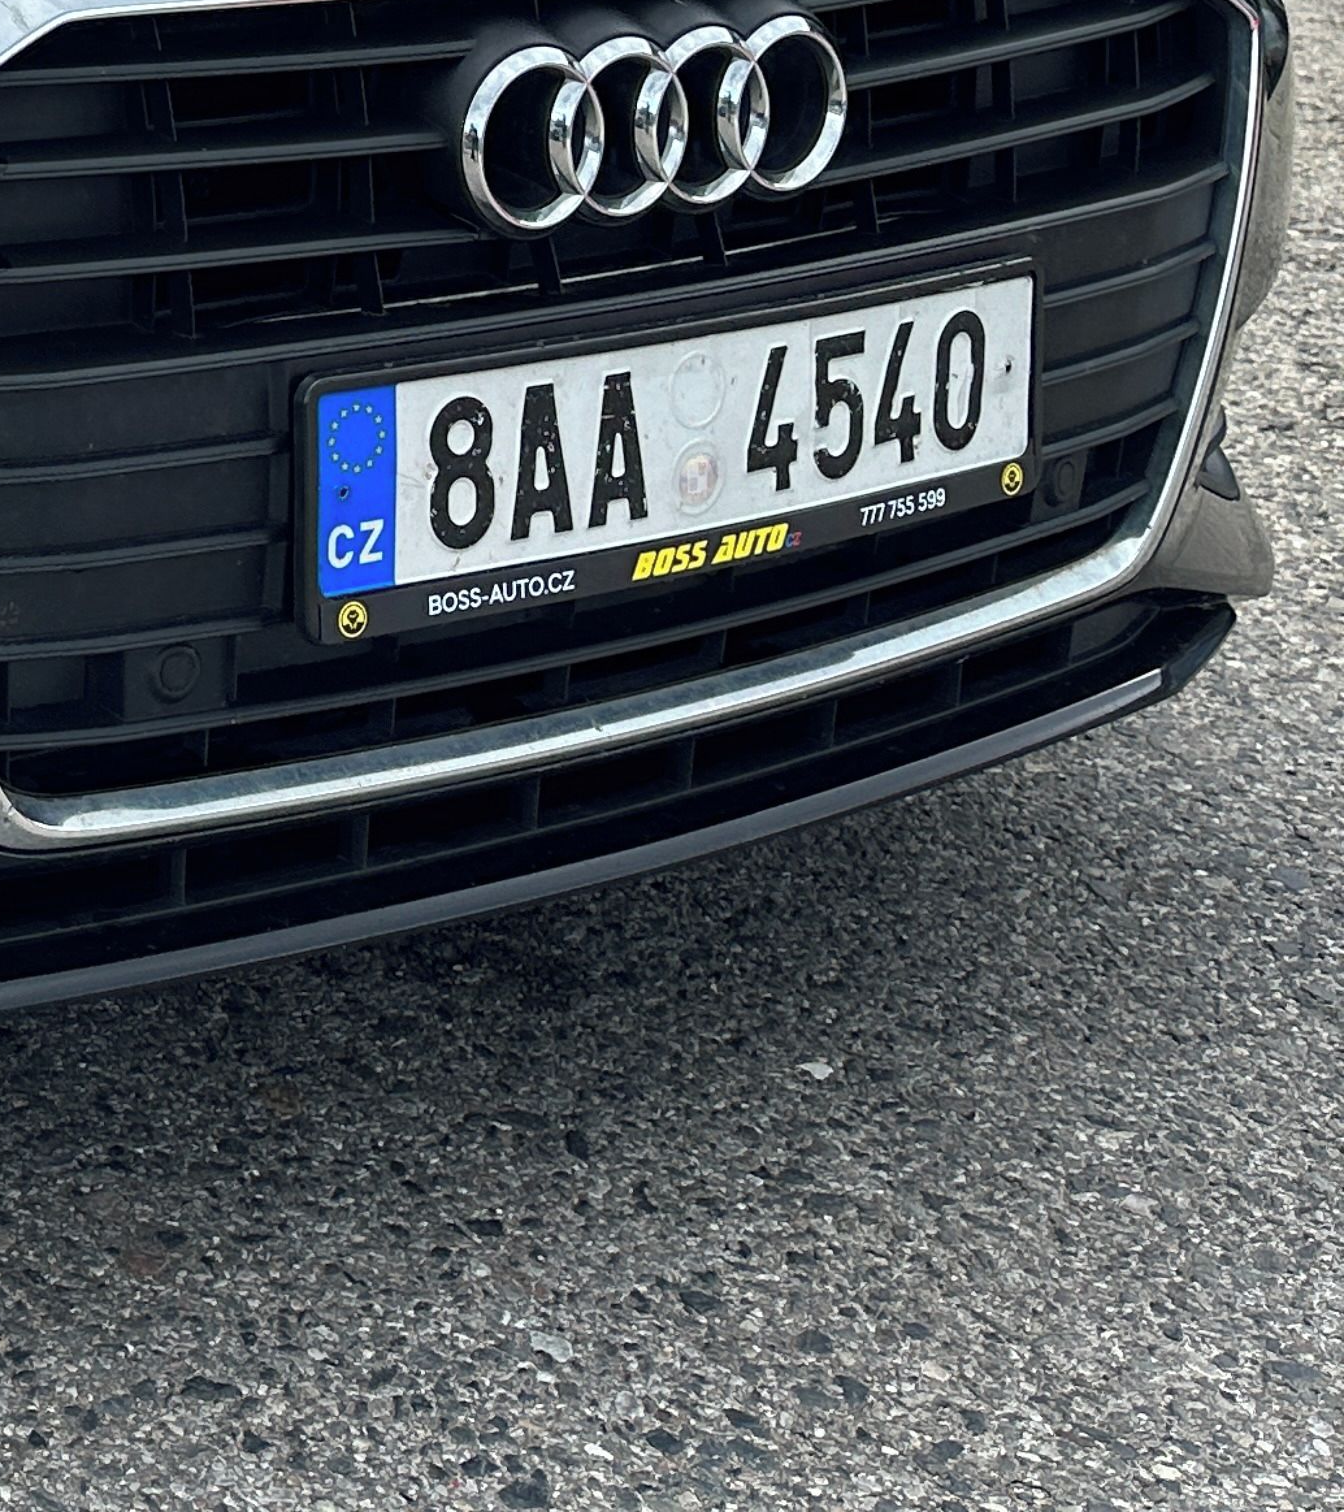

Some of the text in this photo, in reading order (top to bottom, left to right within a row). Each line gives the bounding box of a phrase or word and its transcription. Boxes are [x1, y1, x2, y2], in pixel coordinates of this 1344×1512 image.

[427, 309, 987, 550] 8AA 4540
[860, 487, 947, 527] 777 755 599
[327, 518, 385, 569] CZ
[631, 540, 709, 582] BOSS
[711, 522, 789, 565] AUTO
[427, 570, 576, 616] BOSS-AUTO.CZ
